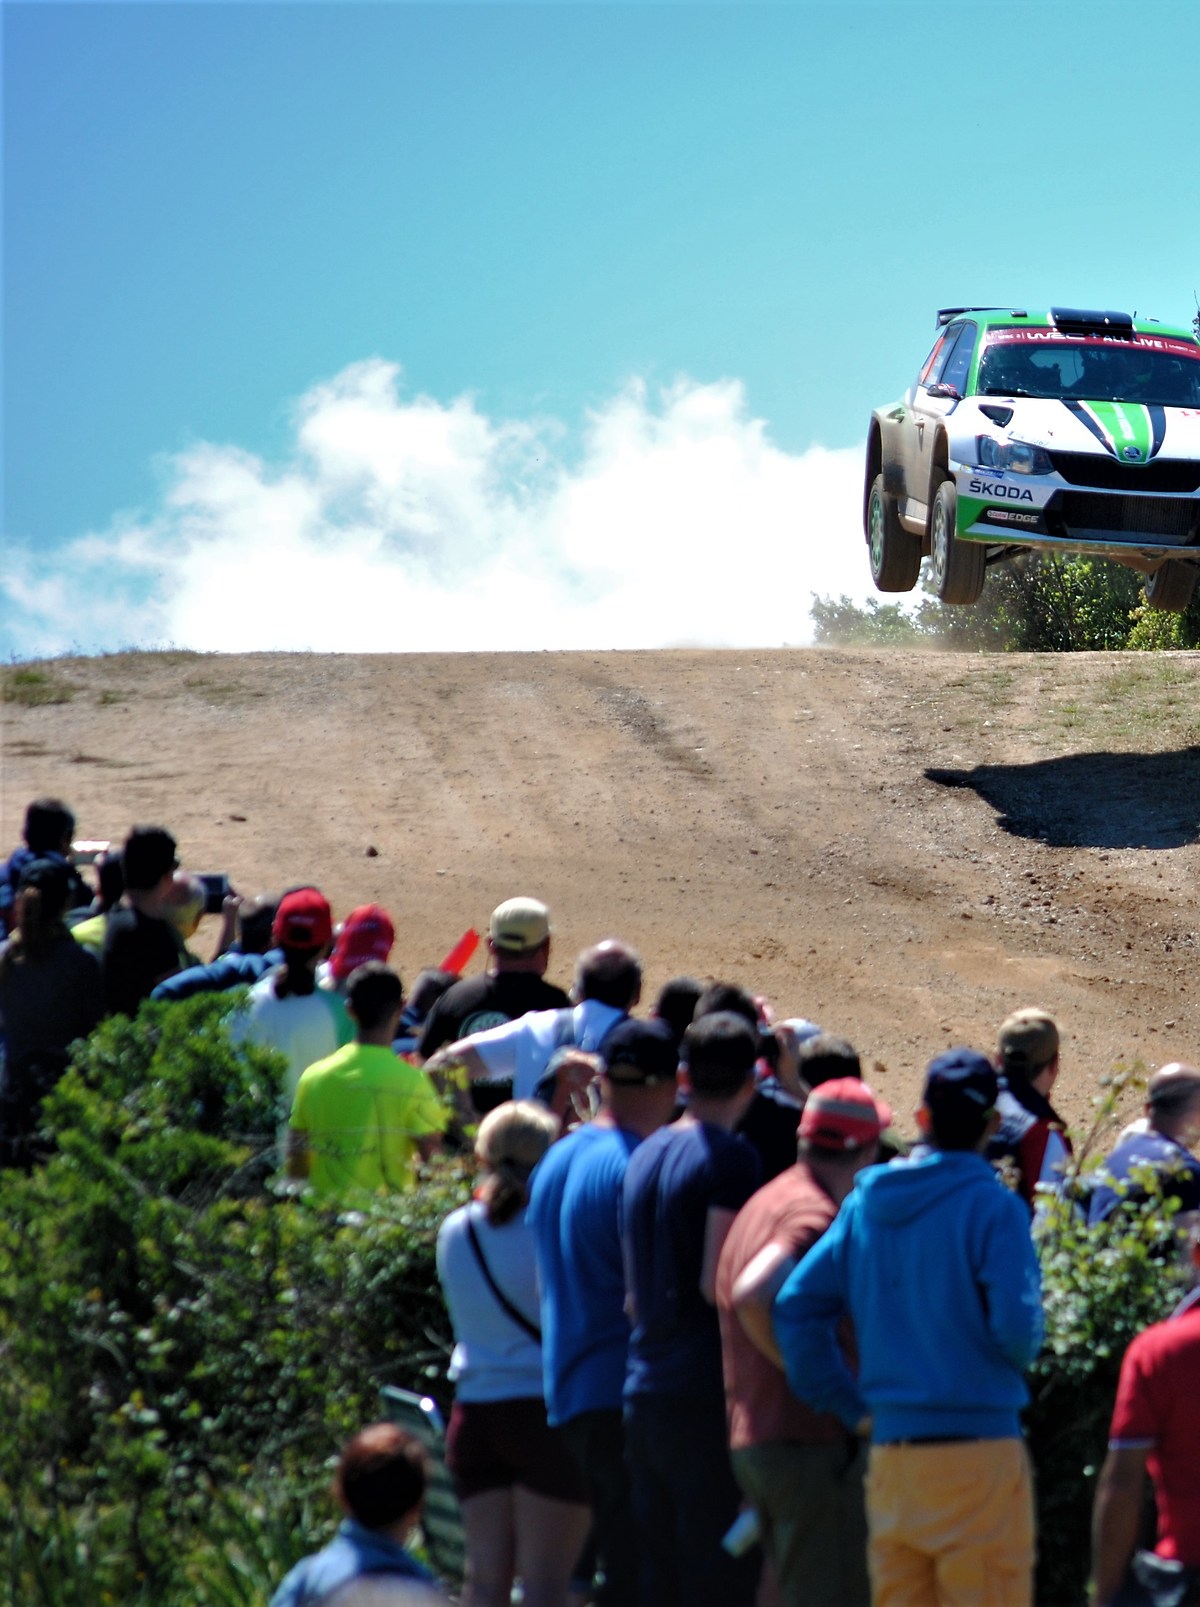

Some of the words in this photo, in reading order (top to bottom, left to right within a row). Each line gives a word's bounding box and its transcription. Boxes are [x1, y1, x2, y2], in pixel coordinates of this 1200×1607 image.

[1103, 335, 1130, 344] ALL
[1132, 337, 1163, 348] LIVE
[968, 478, 1034, 502] ŠKODA
[1008, 513, 1040, 523] EDGE
